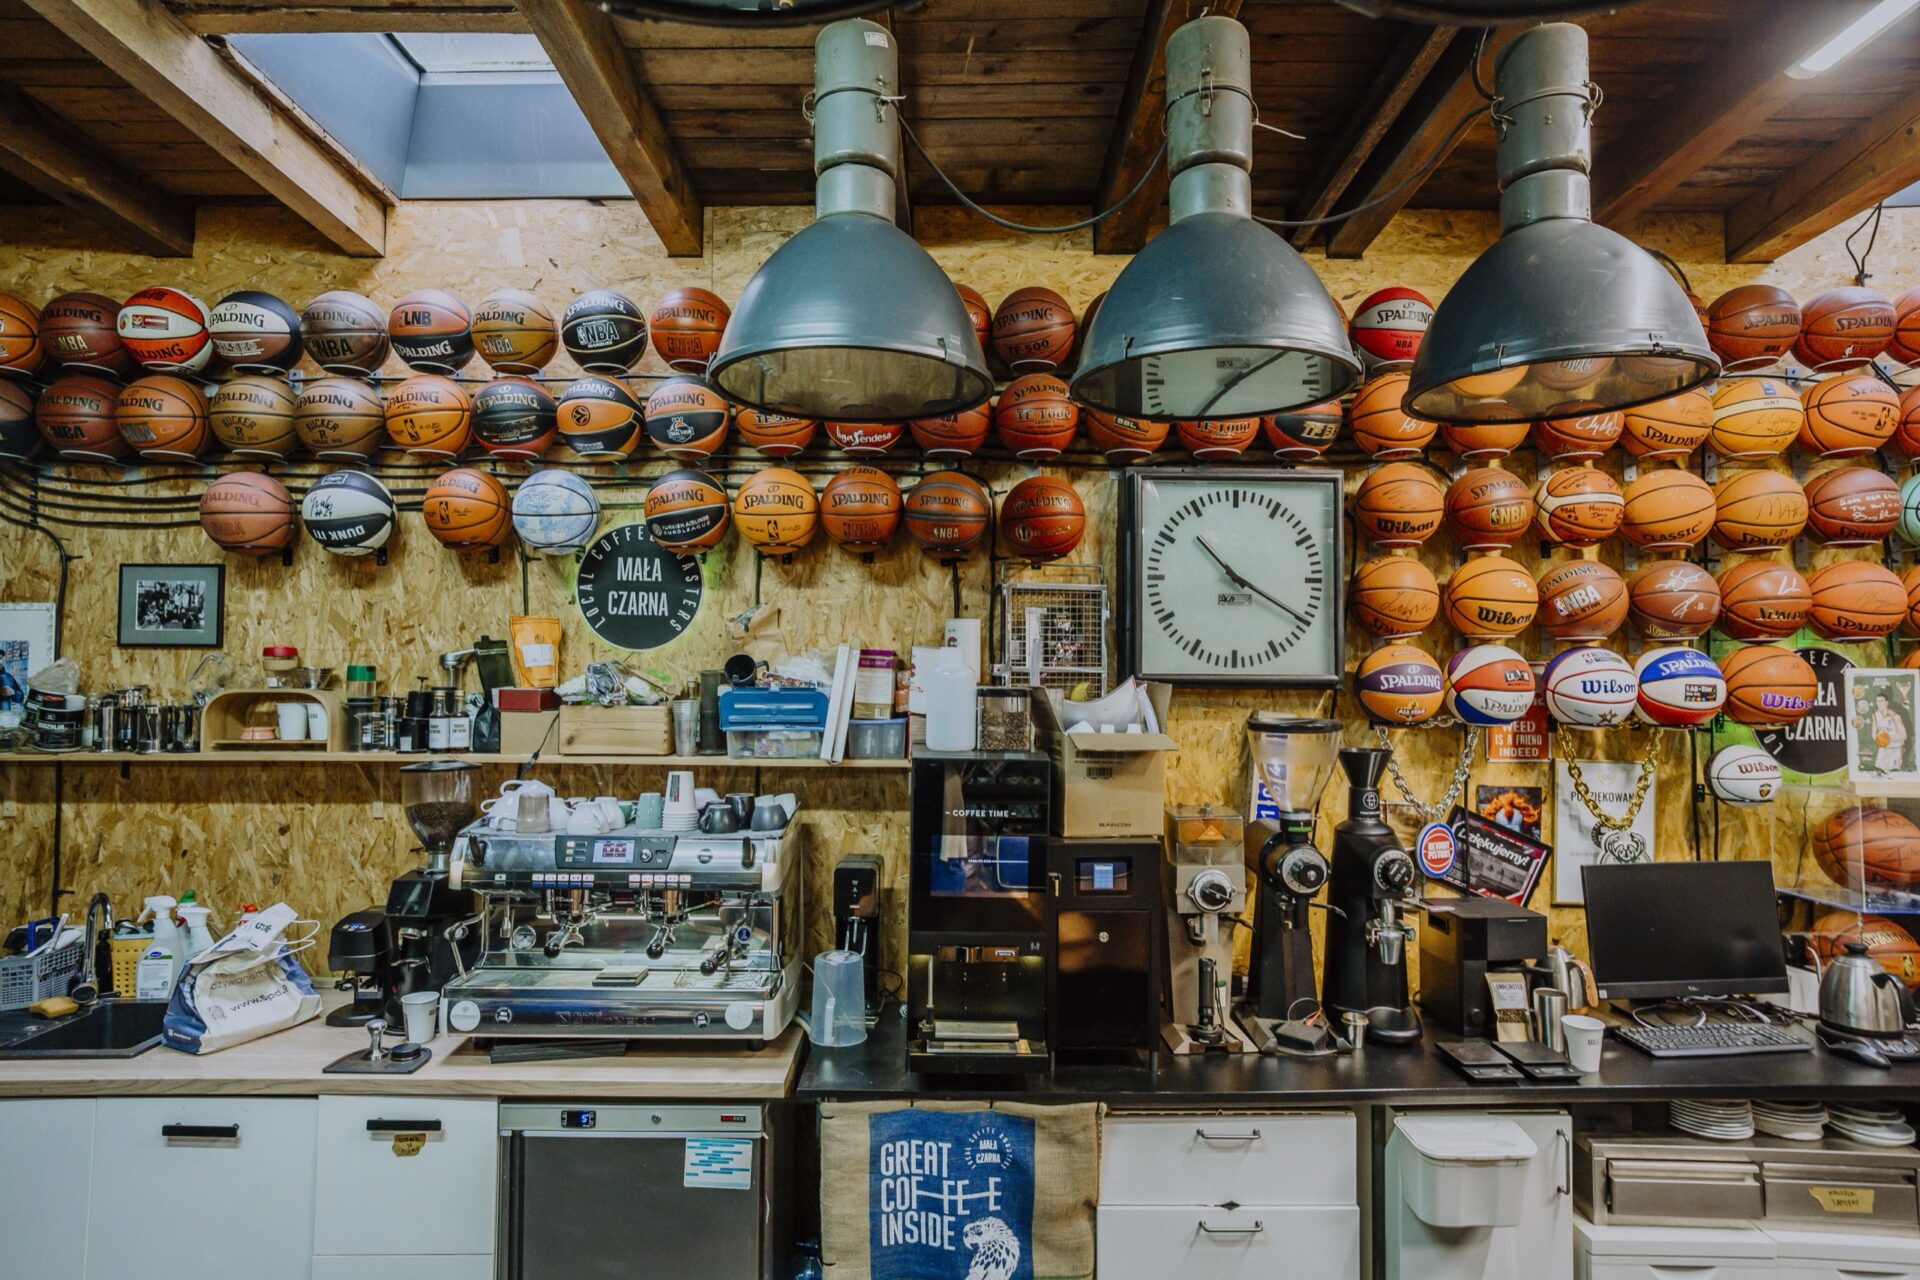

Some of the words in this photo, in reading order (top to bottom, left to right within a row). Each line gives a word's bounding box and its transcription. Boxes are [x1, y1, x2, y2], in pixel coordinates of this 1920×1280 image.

[565, 296, 627, 321] SPALDING
[656, 307, 716, 324] SPALDING
[210, 312, 266, 329] SPALDING
[404, 310, 433, 327] LNB
[471, 310, 525, 327] SPALDING
[997, 307, 1054, 332] SPALDING
[1743, 313, 1800, 331] SPALDIN
[1836, 316, 1895, 332] SPALDIN
[585, 321, 620, 344] NBA
[133, 343, 186, 360] ALDING
[317, 337, 355, 359] NBA
[394, 339, 455, 358] SPALDING
[488, 338, 514, 354] NBA
[1395, 339, 1413, 349] NBA
[212, 391, 275, 410] SPALDING
[296, 394, 357, 411] SPALDING
[385, 391, 442, 412] SPALDING
[477, 393, 541, 415] SPALDING
[649, 393, 706, 414] SPALDING
[222, 416, 257, 430] RUCKER
[234, 426, 244, 437] R
[305, 417, 340, 432] RUCKER
[318, 428, 327, 440] R
[1641, 426, 1705, 447] SPALDING
[1469, 478, 1525, 501] SPALDIN
[648, 488, 705, 513] SPALDING
[743, 494, 804, 510] SPALDING
[831, 492, 890, 508] SPALDING
[919, 494, 969, 508] SPALDING
[661, 522, 686, 531] TURKISH
[685, 515, 710, 527] AIRLINES
[1499, 505, 1528, 524] NBA
[329, 525, 366, 541] DUNK
[663, 520, 712, 536] EUROLEAGUE
[938, 526, 960, 539] NBA
[1376, 516, 1435, 535] Wilson
[1642, 524, 1701, 543] CLASSIC
[1738, 532, 1794, 546] SPALDI
[616, 556, 663, 582] MAŁA
[1540, 565, 1602, 597] SPALDING
[579, 572, 606, 629] LOCAL
[670, 553, 701, 632] OASTERS
[1564, 584, 1603, 611] NBA
[607, 590, 669, 617] CZARNA
[1583, 600, 1602, 613] STAR
[1477, 605, 1532, 625] Wilson
[1756, 606, 1808, 621] SPALDI
[1833, 615, 1896, 633] SPALDIN
[1657, 659, 1719, 677] SPALDIN
[1380, 674, 1441, 691] SPALDING
[1580, 679, 1636, 695] Wilson
[1761, 691, 1815, 711] Wilso
[1814, 681, 1837, 707] ŁA
[1480, 697, 1528, 714] SPALDI
[1502, 721, 1536, 733] WEED
[1495, 733, 1504, 746] IS
[1506, 733, 1514, 745] A
[1516, 733, 1543, 746] FRIEND
[1499, 747, 1540, 758] INDEED
[1737, 763, 1780, 775] Wilson
[1570, 790, 1635, 803] POZIĘKOWAN
[952, 809, 986, 818] COFFEE
[988, 809, 1009, 818] TIME
[968, 1126, 996, 1143] COFFEE
[978, 1138, 998, 1150] MAŁA
[998, 1131, 1014, 1171] ROASTERS
[880, 1138, 953, 1178] GREAT
[964, 1146, 977, 1170] LOCAL
[975, 1152, 1002, 1165] CZARNA
[880, 1176, 1003, 1216] COFFEE
[881, 1210, 956, 1252] INSIDE
